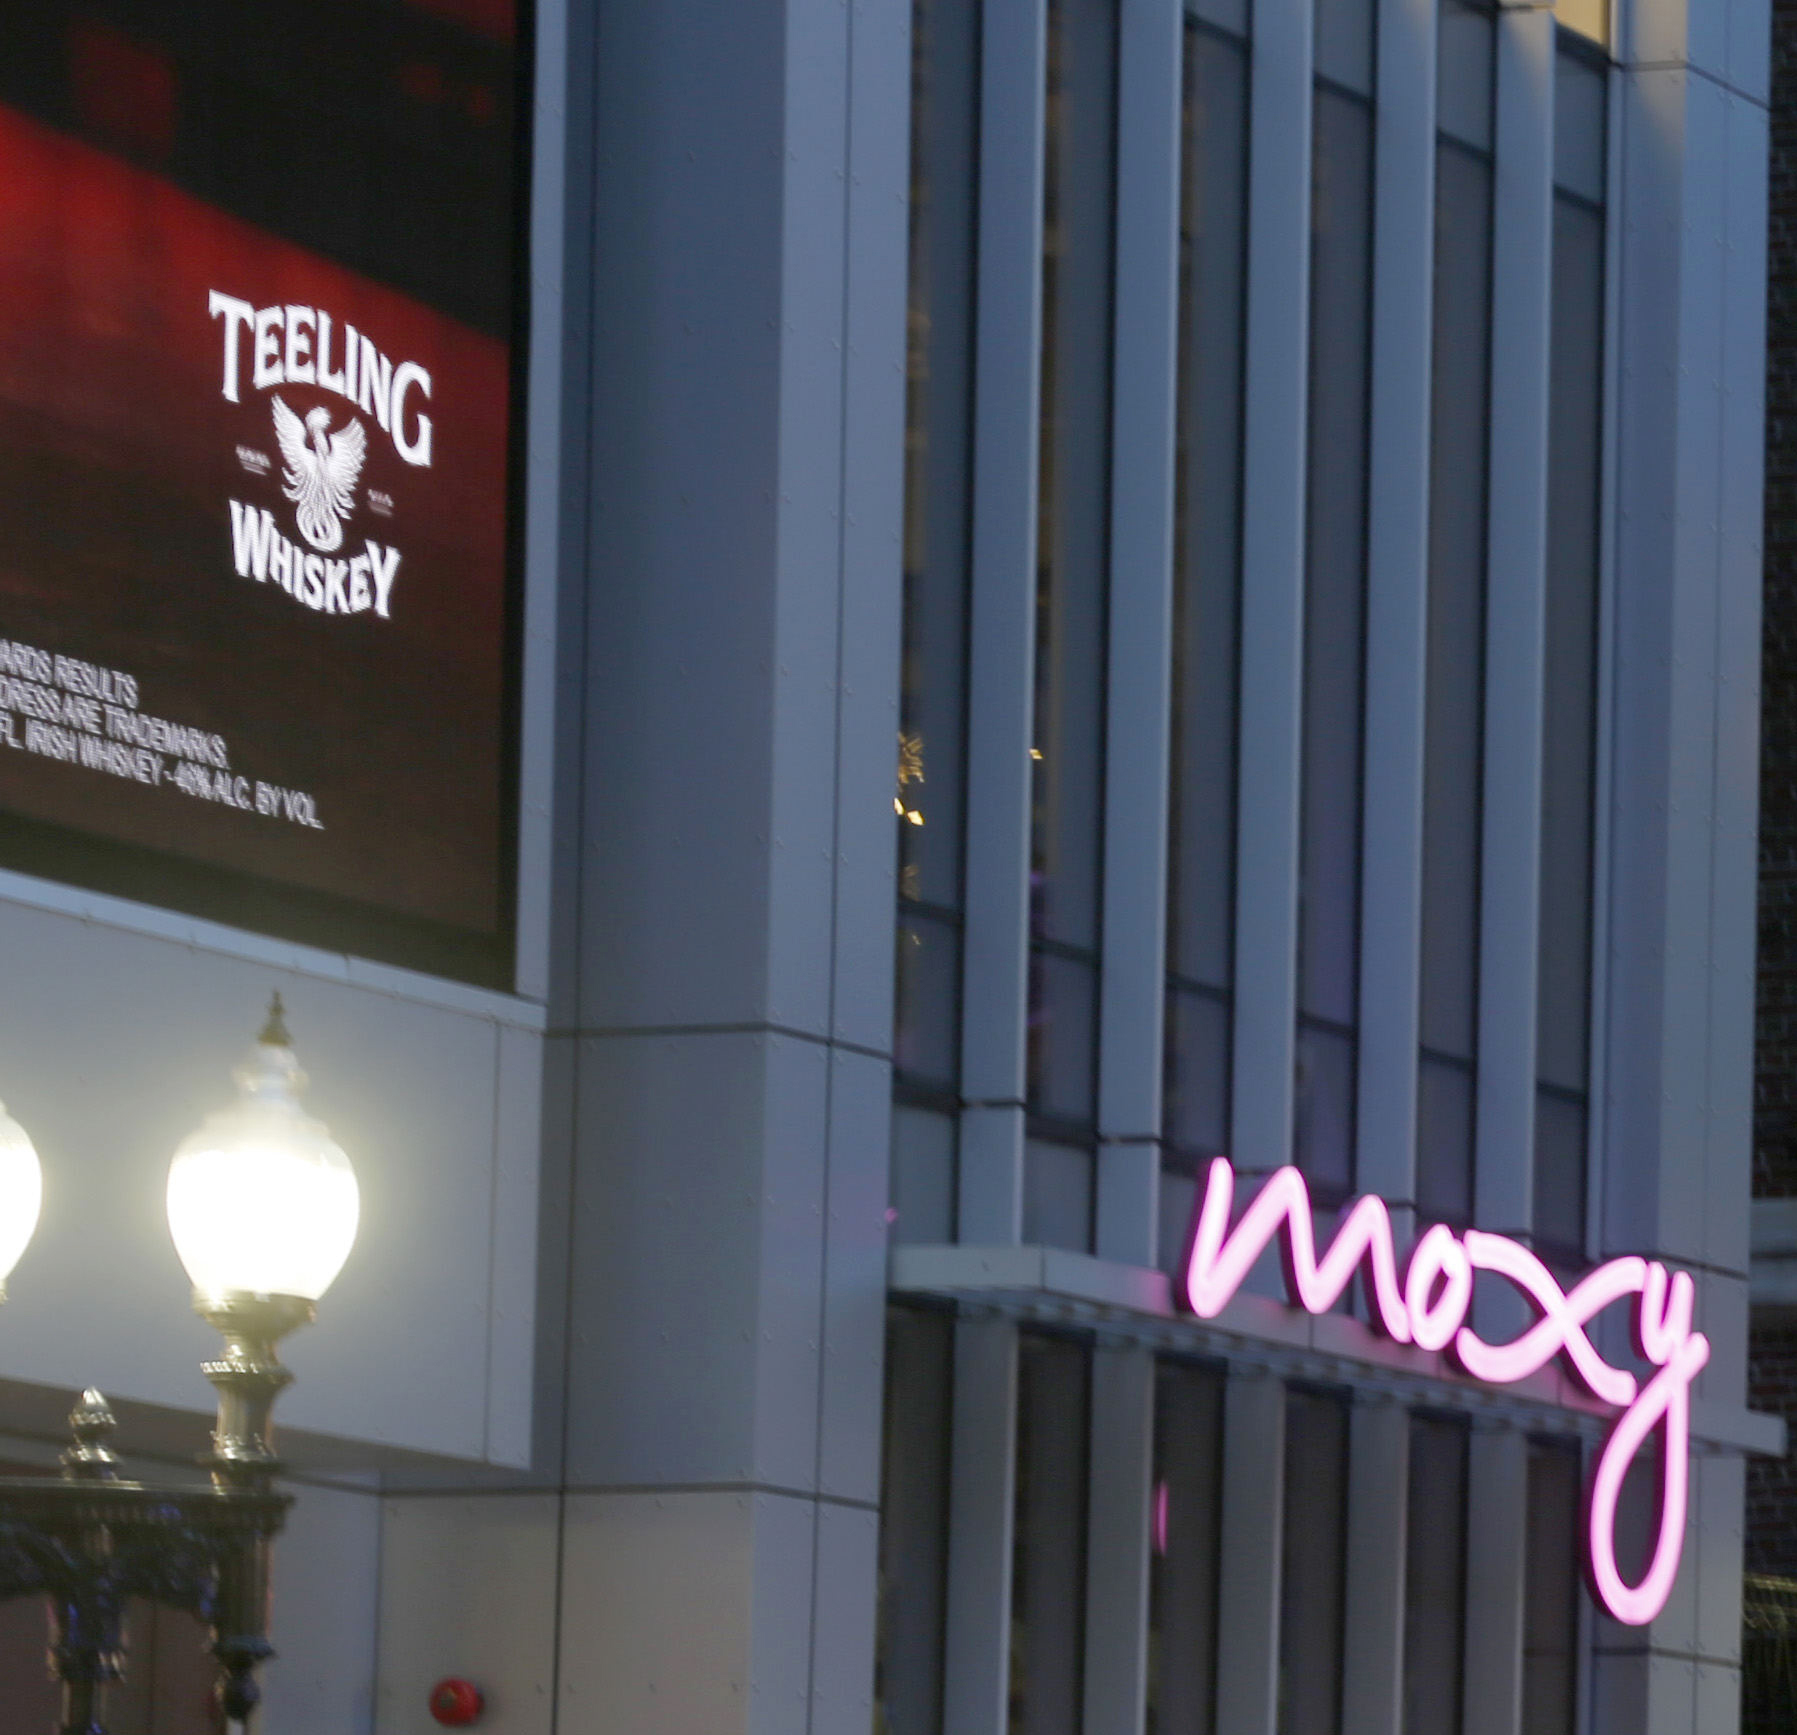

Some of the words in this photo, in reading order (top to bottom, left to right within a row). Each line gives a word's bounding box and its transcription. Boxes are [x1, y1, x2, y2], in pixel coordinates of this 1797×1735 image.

[208, 288, 432, 468] TEELING
[229, 499, 402, 620] WHISKEY
[54, 654, 140, 710] RESULTS
[25, 718, 78, 764] IRISH
[78, 732, 165, 787] WHISKEY
